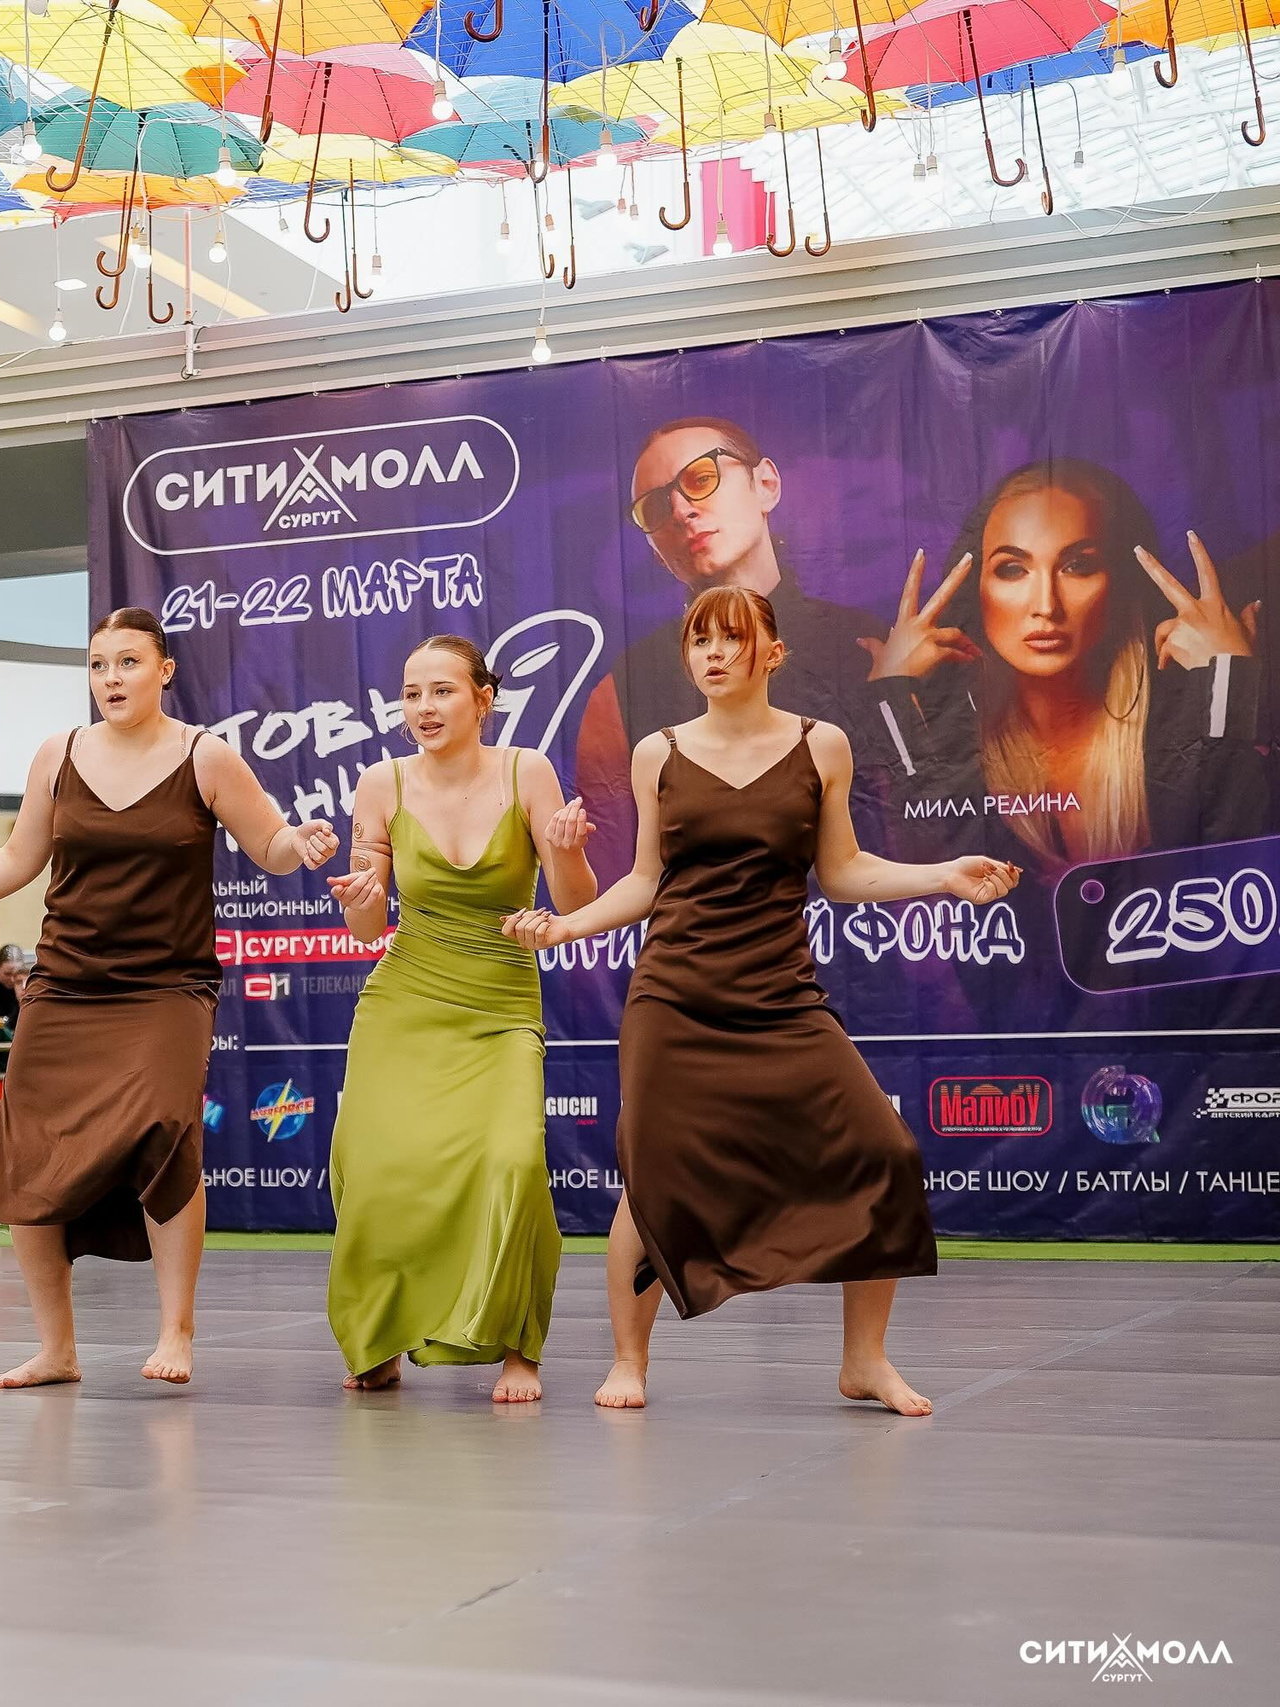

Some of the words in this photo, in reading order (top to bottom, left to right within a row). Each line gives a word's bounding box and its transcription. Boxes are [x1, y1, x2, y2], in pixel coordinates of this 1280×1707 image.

[155, 461, 288, 511] СИТИ
[331, 440, 485, 491] МОЛЛ
[278, 509, 342, 529] СУРГУТ
[161, 574, 313, 633] 21-22
[322, 552, 483, 619] МАРТА
[904, 797, 977, 820] МИЛА
[983, 791, 1081, 816] РЕДИНА
[1106, 868, 1280, 964] 250
[843, 900, 1025, 965] ФОНД
[545, 1096, 598, 1116] GUCHI
[261, 1167, 312, 1187] ШОУ
[987, 1170, 1050, 1191] ШОУ
[1076, 1171, 1170, 1192] БАТТЛЫ
